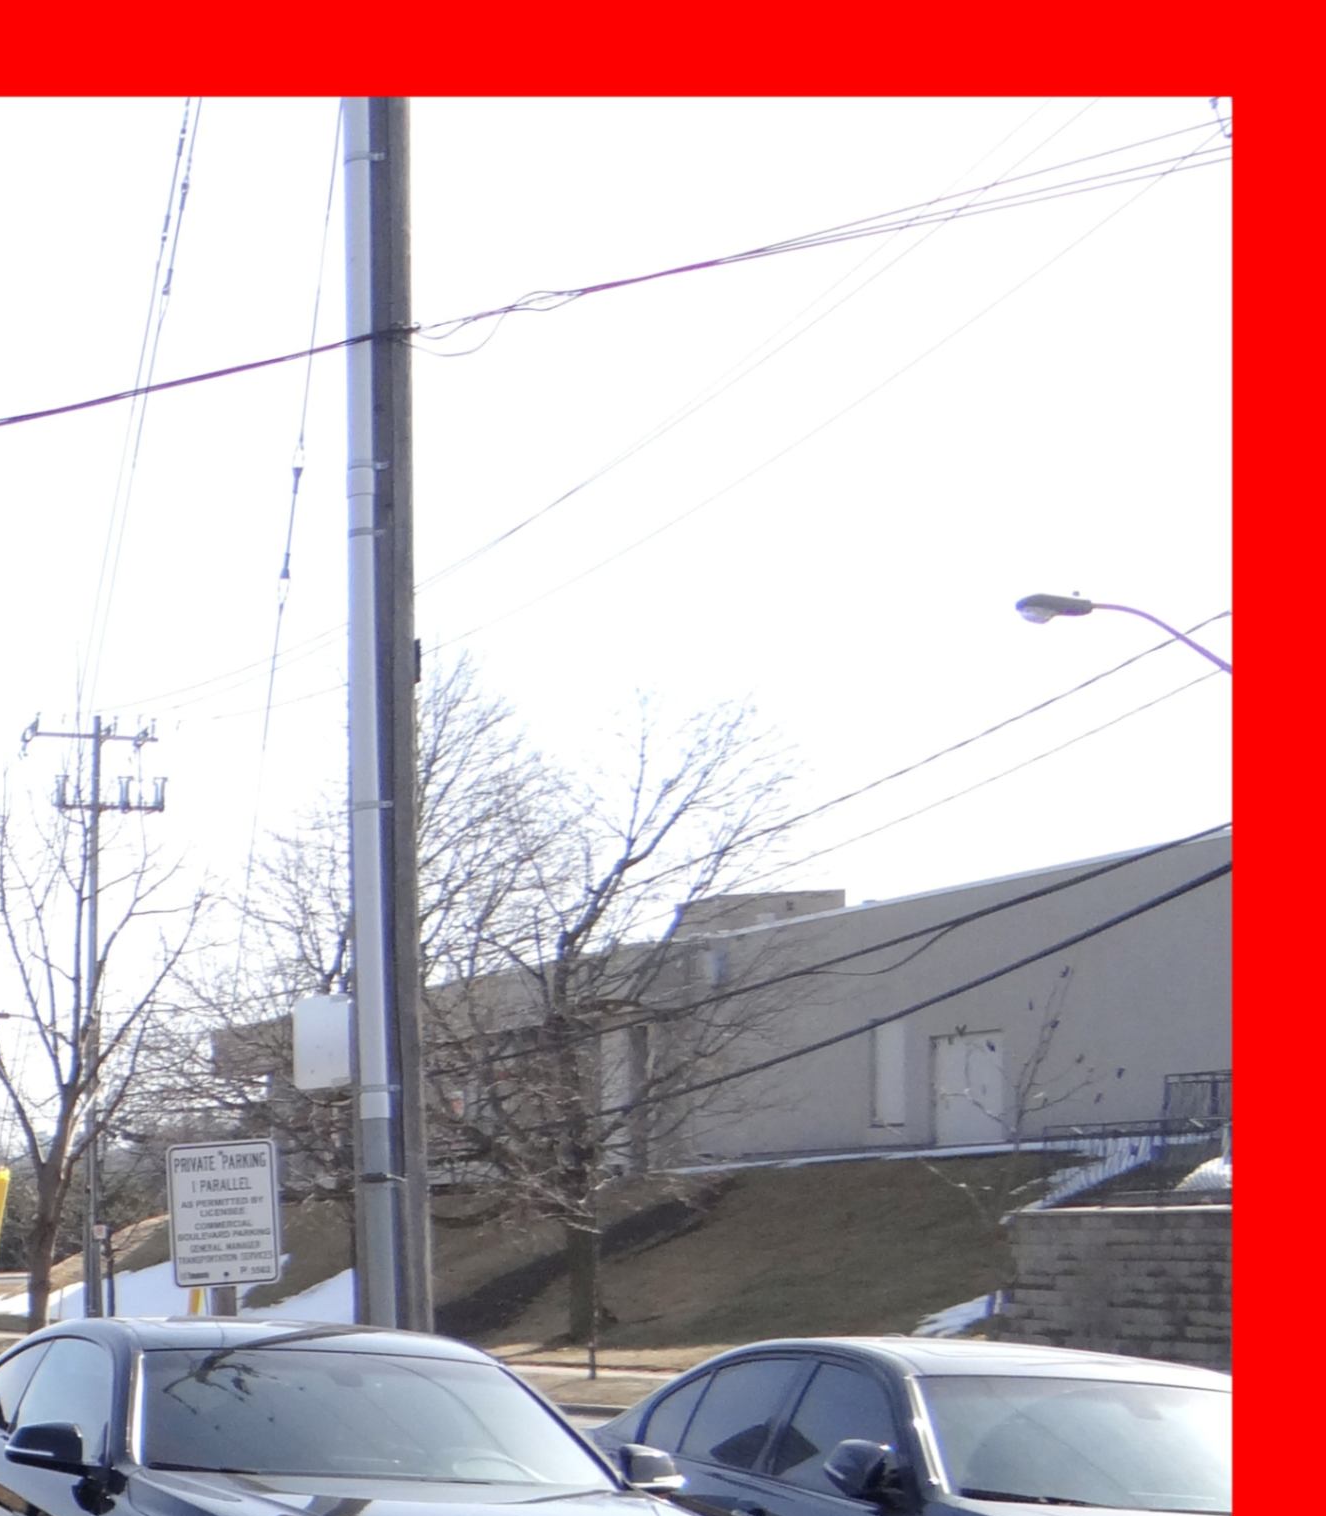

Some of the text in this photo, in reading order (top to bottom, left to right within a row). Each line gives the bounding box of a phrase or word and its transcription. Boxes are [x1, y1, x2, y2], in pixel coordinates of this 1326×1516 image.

[174, 1152, 267, 1173] PRIVATE PARKING
[200, 1177, 252, 1192] PARALLEL
[181, 1196, 264, 1209] AS PERMITTED BY
